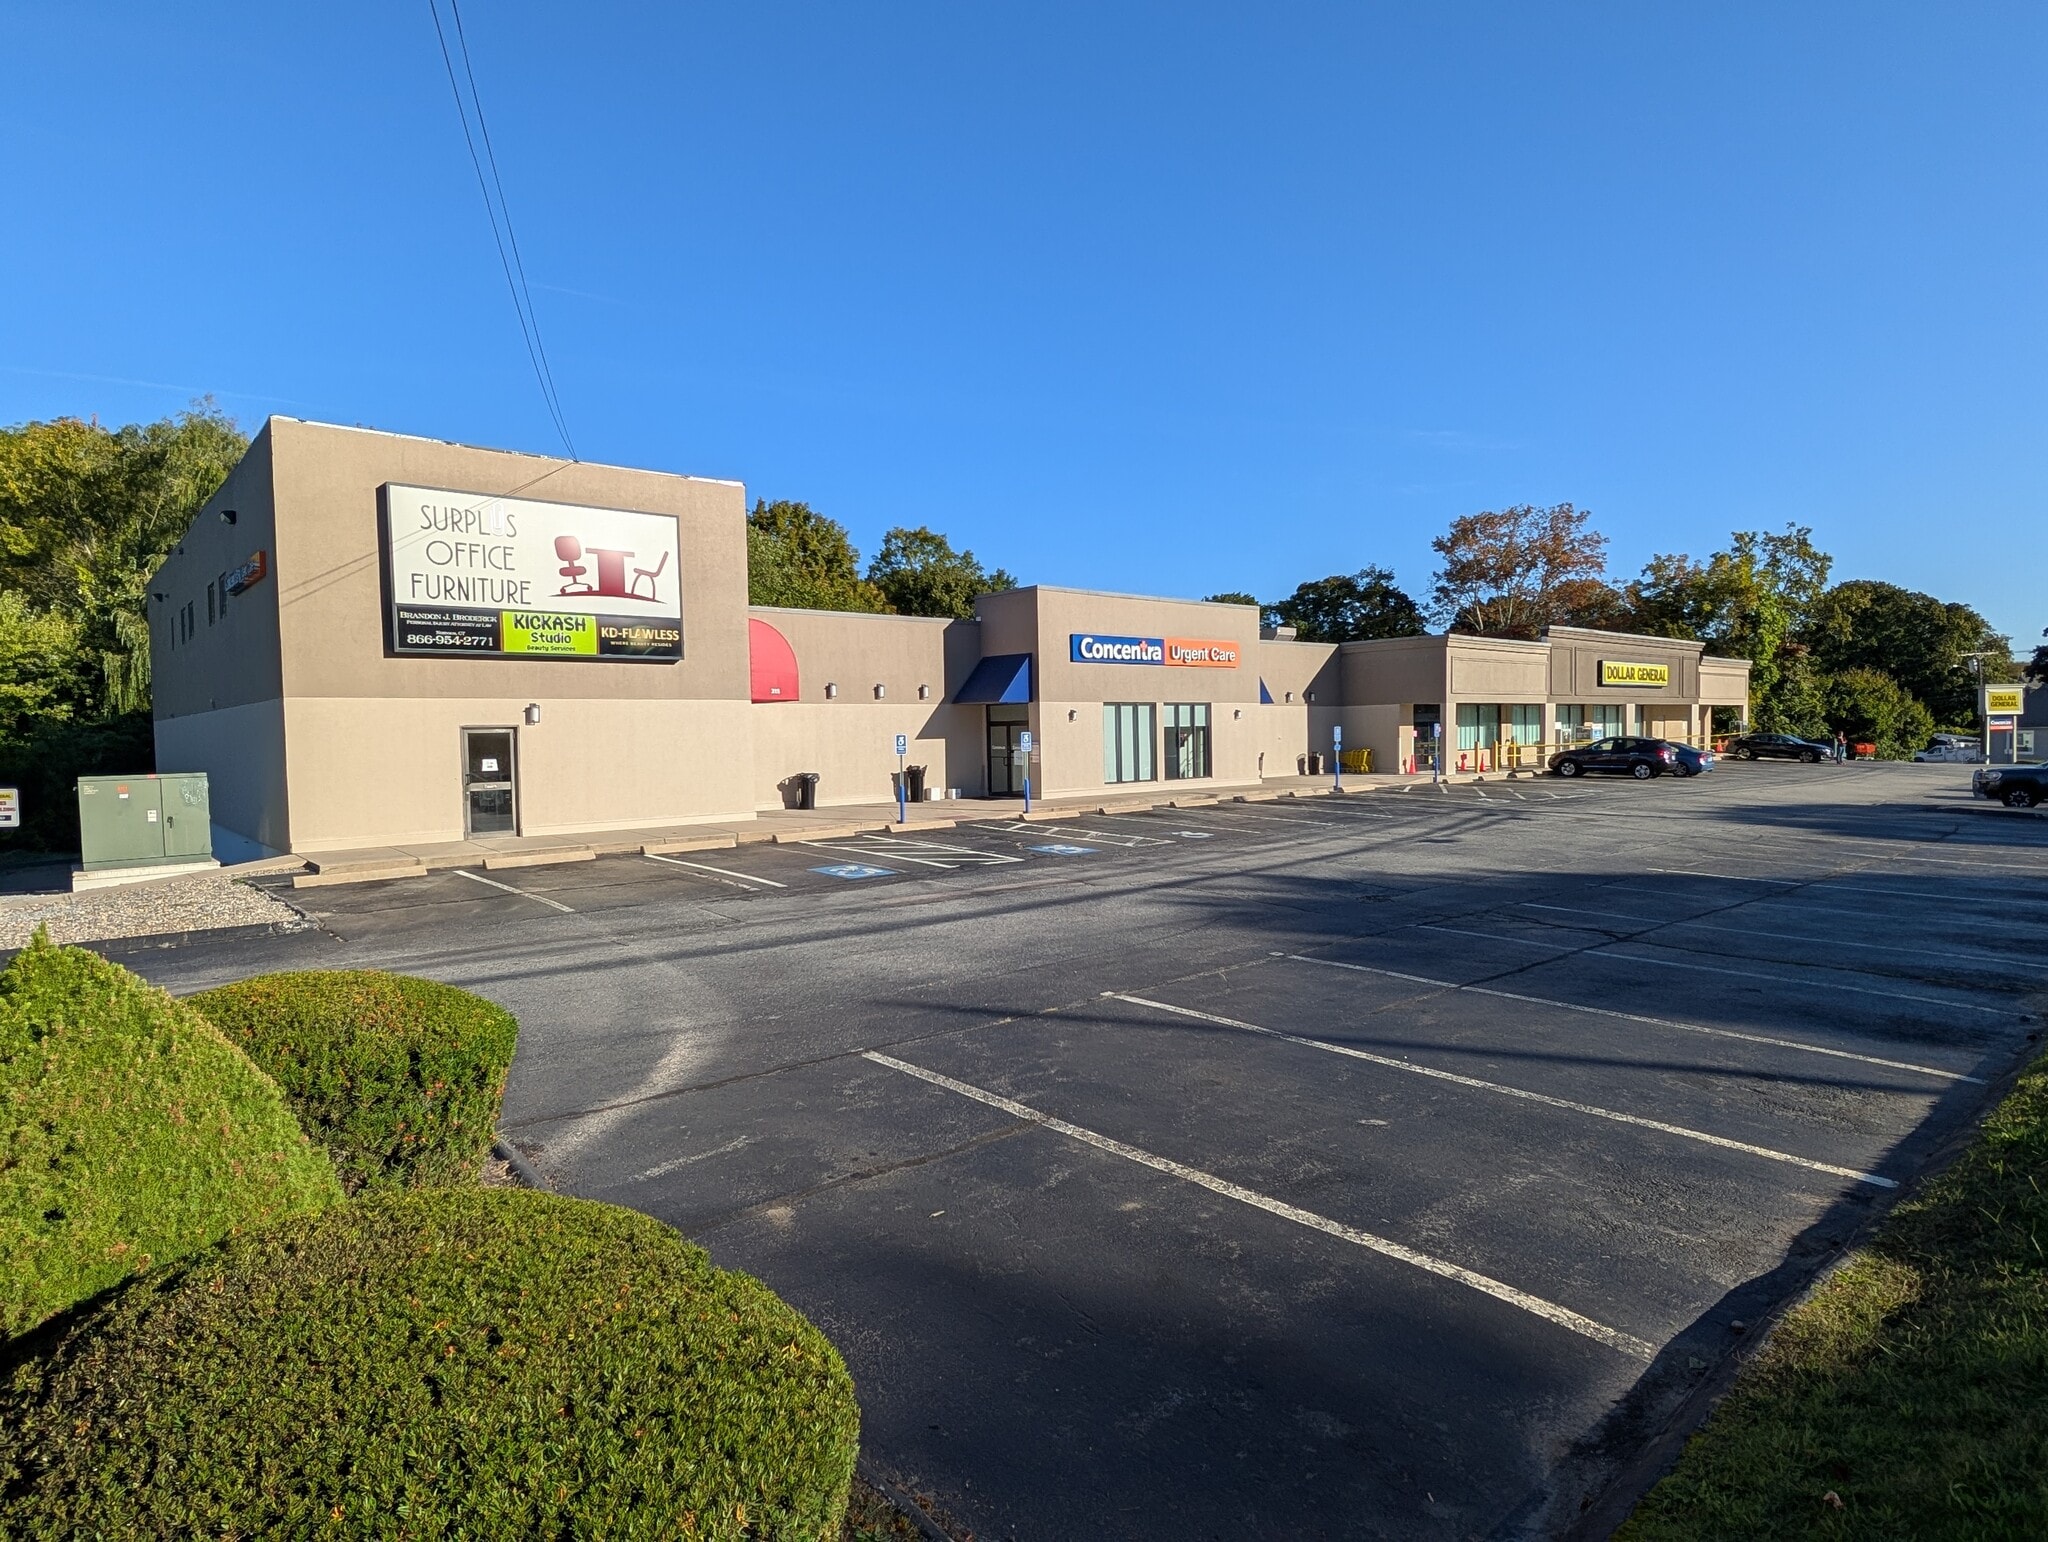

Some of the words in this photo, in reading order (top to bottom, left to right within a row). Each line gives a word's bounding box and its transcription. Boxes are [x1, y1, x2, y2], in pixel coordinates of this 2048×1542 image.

[420, 505, 517, 538] SURPLUS
[426, 540, 516, 571] OFFICE
[411, 573, 532, 605] FURNITURE
[400, 611, 441, 620] BRANDON
[453, 614, 497, 622] BRODERICK
[514, 614, 586, 632] KICKASH
[407, 634, 493, 646] 866-954-2771
[531, 632, 572, 644] Studio
[601, 627, 680, 641] KD-FLAWLESS
[1081, 637, 1162, 661] Concentra
[1172, 646, 1209, 663] Urgent
[1211, 647, 1236, 662] Care
[1606, 666, 1635, 680] DOLLAR
[1637, 667, 1666, 682] GENERAL
